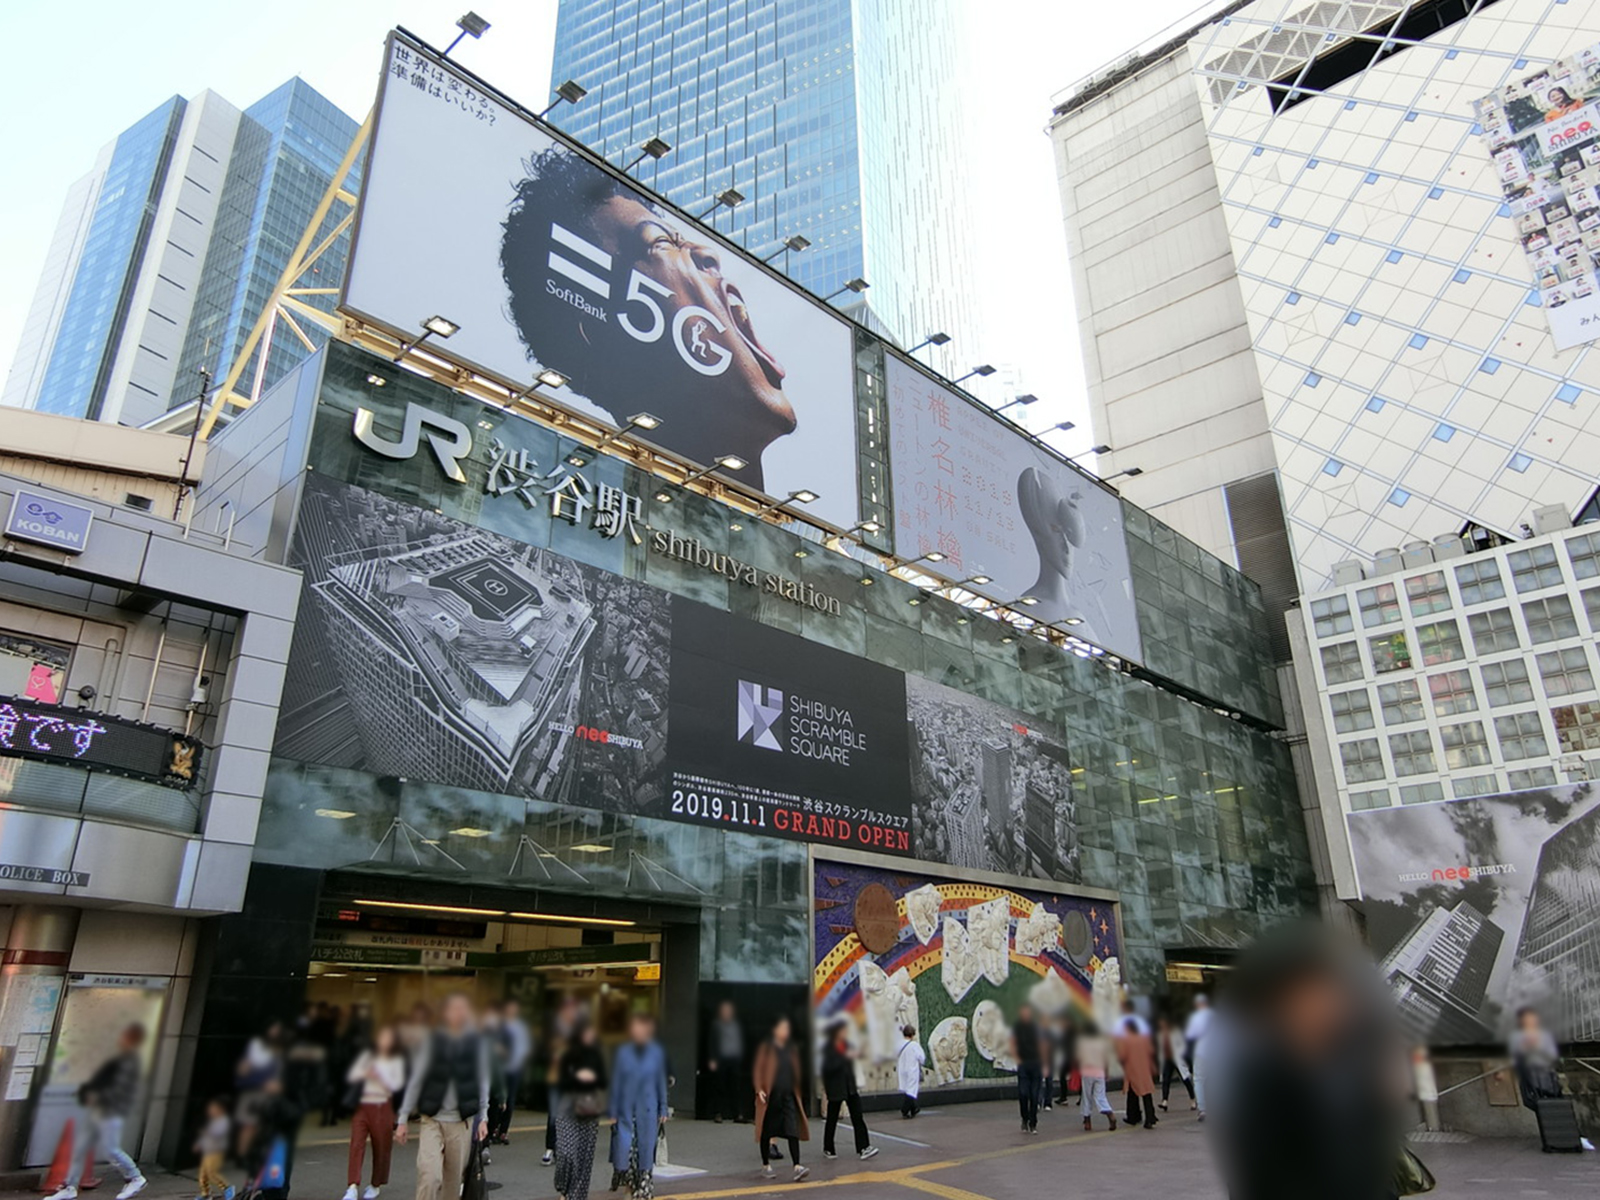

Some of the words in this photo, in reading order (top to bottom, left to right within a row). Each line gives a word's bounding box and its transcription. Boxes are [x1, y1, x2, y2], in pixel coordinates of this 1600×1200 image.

[394, 46, 495, 113] 世界は変わる。
[545, 279, 608, 323] SoftBank
[616, 268, 733, 376] 5G
[352, 401, 473, 485] JR
[485, 436, 643, 546] 渋谷駅
[17, 517, 80, 543] KOBAN
[654, 529, 759, 587] shibuya
[765, 570, 841, 616] station
[548, 721, 575, 734] HELLO
[789, 694, 854, 728] SHIBUYA
[789, 715, 867, 751] SCRAMBLE
[789, 736, 850, 767] SQUARE
[671, 789, 766, 827] 2019.11.1
[802, 796, 909, 829] 渋谷スクランブルスクエア
[773, 808, 852, 841] GRAND
[858, 824, 910, 851] OPEN
[51, 870, 81, 885] BOX
[1398, 871, 1429, 883] HELLO
